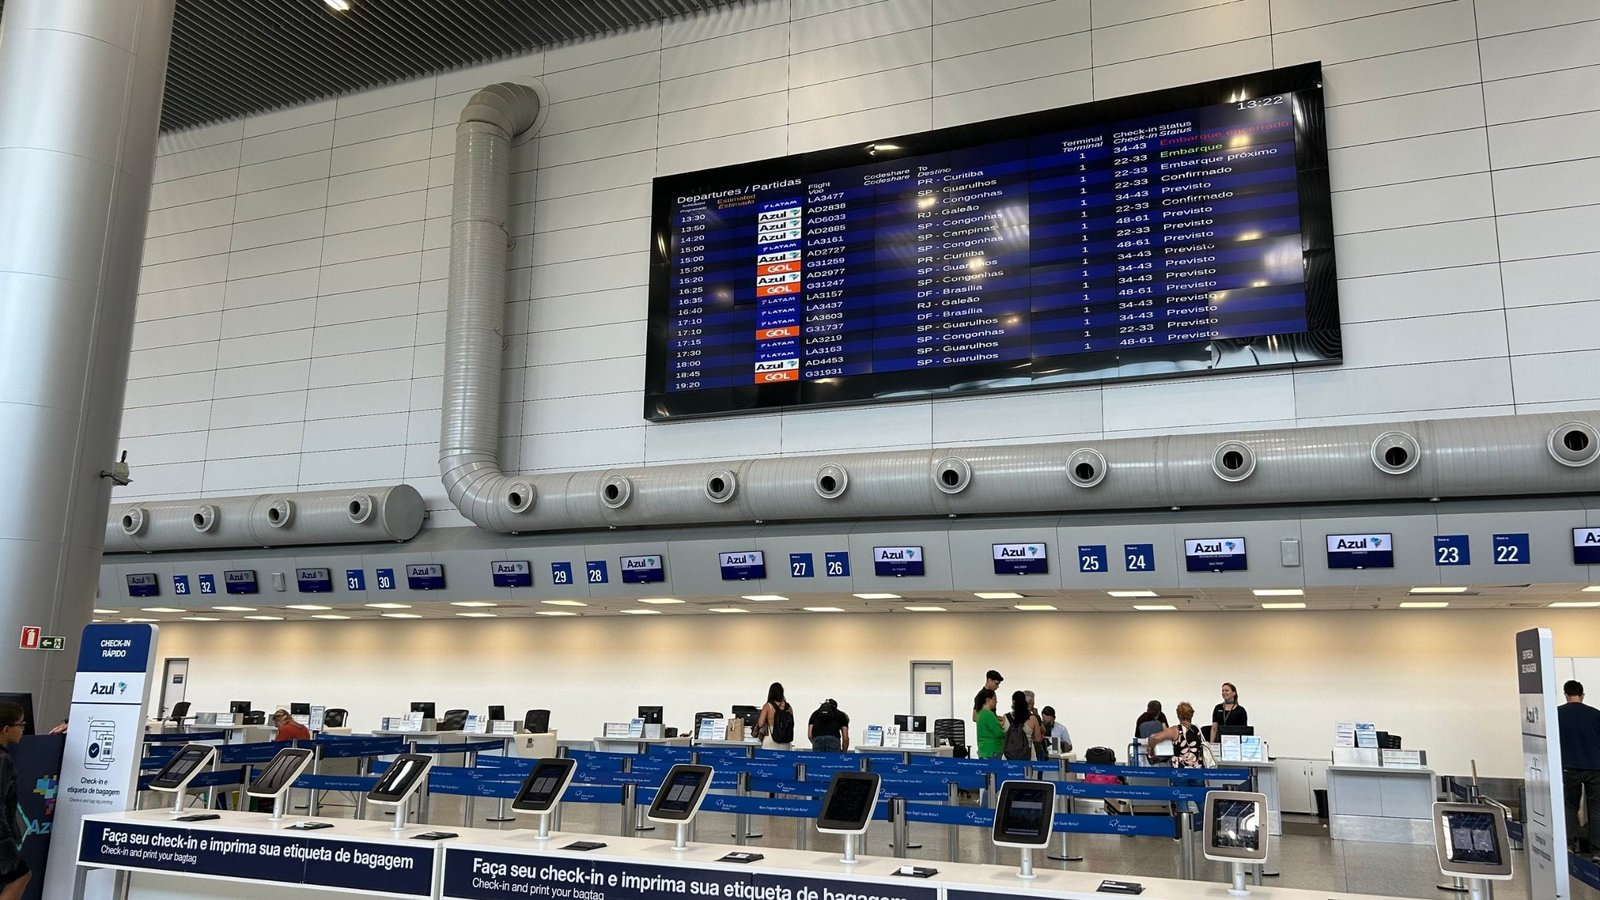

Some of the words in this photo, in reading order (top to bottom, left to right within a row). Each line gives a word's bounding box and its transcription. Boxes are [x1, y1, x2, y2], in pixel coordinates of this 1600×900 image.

[1237, 96, 1283, 111] 13:22
[808, 181, 830, 191] Flight
[864, 169, 910, 180] Codeshare
[1062, 135, 1102, 147] Terminal
[1113, 127, 1157, 138] Check-in
[1159, 121, 1191, 131] Status
[864, 175, 910, 186] Codeshare
[918, 168, 951, 177] Destino
[1062, 141, 1103, 153] Terminal
[1113, 132, 1157, 144] Check-in
[1159, 127, 1192, 136] Status
[682, 214, 705, 222] 13:30
[768, 200, 798, 208] LATAM
[808, 192, 844, 203] LA3477
[943, 170, 984, 181] Curitiba
[1114, 143, 1146, 153] 34-43
[760, 211, 787, 221] Azul
[808, 203, 846, 214] AD2838
[943, 179, 997, 193] Guarulhos
[1115, 155, 1147, 165] 22-33
[1160, 143, 1222, 158] Embarque
[808, 214, 846, 224] AD6033
[943, 189, 1003, 205] Congonhas
[1115, 167, 1147, 177] 22-33
[1161, 154, 1223, 170] Embarque
[1228, 147, 1277, 161] próximo
[677, 189, 741, 203] Departures
[752, 178, 802, 192] Partidas
[807, 225, 845, 235] AD2885
[942, 204, 980, 215] Galeão
[1115, 179, 1148, 189] 22-33
[1161, 167, 1232, 181] Confirmado
[808, 236, 843, 246] LA3161
[943, 212, 1003, 227] Congonhas
[1116, 191, 1148, 200] 34-43
[1162, 183, 1211, 193] Previsto
[807, 246, 845, 257] AD2727
[943, 225, 997, 239] Campinas
[1116, 202, 1149, 212] 22-33
[1162, 192, 1233, 205] Confirmado
[807, 258, 844, 267] G31259
[943, 236, 1003, 250] Congonhas
[1116, 215, 1149, 223] 48-61
[1163, 207, 1212, 218] Previsto
[807, 268, 845, 278] AD2977
[944, 250, 984, 261] Curitiba
[1117, 227, 1150, 236] 22-33
[1164, 219, 1213, 230] Previsto
[807, 279, 844, 289] G31247
[943, 259, 998, 272] Guaros
[1117, 239, 1150, 247] 48-61
[1164, 232, 1214, 242] Previsto
[807, 290, 843, 300] LA3157
[943, 270, 1004, 283] Congonhas
[1118, 251, 1151, 259] 34-43
[1165, 244, 1214, 254] Previsto
[807, 302, 843, 311] LA3437
[943, 284, 983, 295] Brasília
[1118, 263, 1152, 271] 34-43
[1166, 256, 1215, 266] Previsto
[807, 313, 842, 322] LA3603
[942, 297, 980, 305] Galeão
[1119, 275, 1152, 284] 34-43
[1166, 269, 1216, 278] Previsto
[806, 323, 843, 332] G31737
[943, 308, 982, 317] Brasília
[1119, 287, 1152, 295] 48-61
[1167, 281, 1216, 290] Previsto
[806, 335, 842, 344] LA3219
[943, 318, 998, 329] Guarulhos
[1119, 300, 1153, 309] 34-43
[1167, 292, 1217, 303] Previsto
[806, 346, 842, 355] LA3163
[943, 329, 1005, 341] Congonhas
[1120, 312, 1153, 321] 34-43
[1167, 304, 1218, 316] Previsto
[805, 357, 843, 366] AD4453
[943, 342, 998, 351] Guarulhos
[1120, 324, 1154, 333] 22-33
[1168, 318, 1218, 328] Previsto
[806, 368, 843, 378] G31931
[943, 354, 998, 363] Guarulhos
[1120, 337, 1154, 345] 48-61
[1168, 330, 1219, 340] Previsto
[1001, 546, 1026, 557] Azul
[1195, 542, 1222, 553] Azul
[1337, 538, 1367, 549] Azul
[726, 554, 747, 565] Azul
[881, 550, 904, 560] Azul
[1128, 554, 1146, 569] 24
[1438, 547, 1459, 563] 23
[1497, 546, 1518, 562] 22
[498, 563, 515, 573] Azul
[627, 557, 647, 568] Azul
[793, 563, 806, 576] 27
[828, 562, 842, 575] 26
[1082, 555, 1099, 570] 25
[230, 574, 243, 582] Azul
[302, 571, 317, 580] Azul
[413, 567, 429, 576] Azul
[554, 570, 567, 583] 29
[590, 569, 602, 582] 28
[176, 583, 186, 593] 33
[201, 582, 211, 593] 32
[349, 577, 359, 589] 31
[379, 576, 390, 588] 30
[100, 639, 131, 647] CHECK-IN
[102, 649, 126, 658] RÁPIDO
[90, 682, 115, 695] Azul
[67, 786, 87, 794] etiqueta
[96, 788, 120, 796] bagagem
[101, 844, 129, 856] Check-in
[130, 848, 142, 858] and
[143, 849, 158, 860] print
[158, 852, 173, 861] your
[174, 852, 197, 864] bagtag
[102, 828, 127, 845] Faça
[130, 832, 149, 845] seu
[151, 833, 197, 849] check-in
[200, 839, 207, 850] e
[210, 837, 256, 855] imprima
[259, 843, 280, 856] sua
[283, 843, 332, 862] etiqueta
[335, 848, 350, 862] de
[354, 849, 413, 870] bagagem
[473, 858, 507, 879] Faça
[510, 865, 536, 879] seu
[540, 865, 604, 886] check-in
[608, 874, 617, 886] e
[622, 871, 685, 893] imprima
[690, 880, 720, 896] sua
[723, 881, 792, 900] etiqueta
[796, 886, 819, 900] de
[472, 877, 510, 891] Check-in
[512, 882, 528, 894] and
[530, 884, 550, 897] print
[551, 888, 571, 899] your
[573, 889, 604, 900] bagtag
